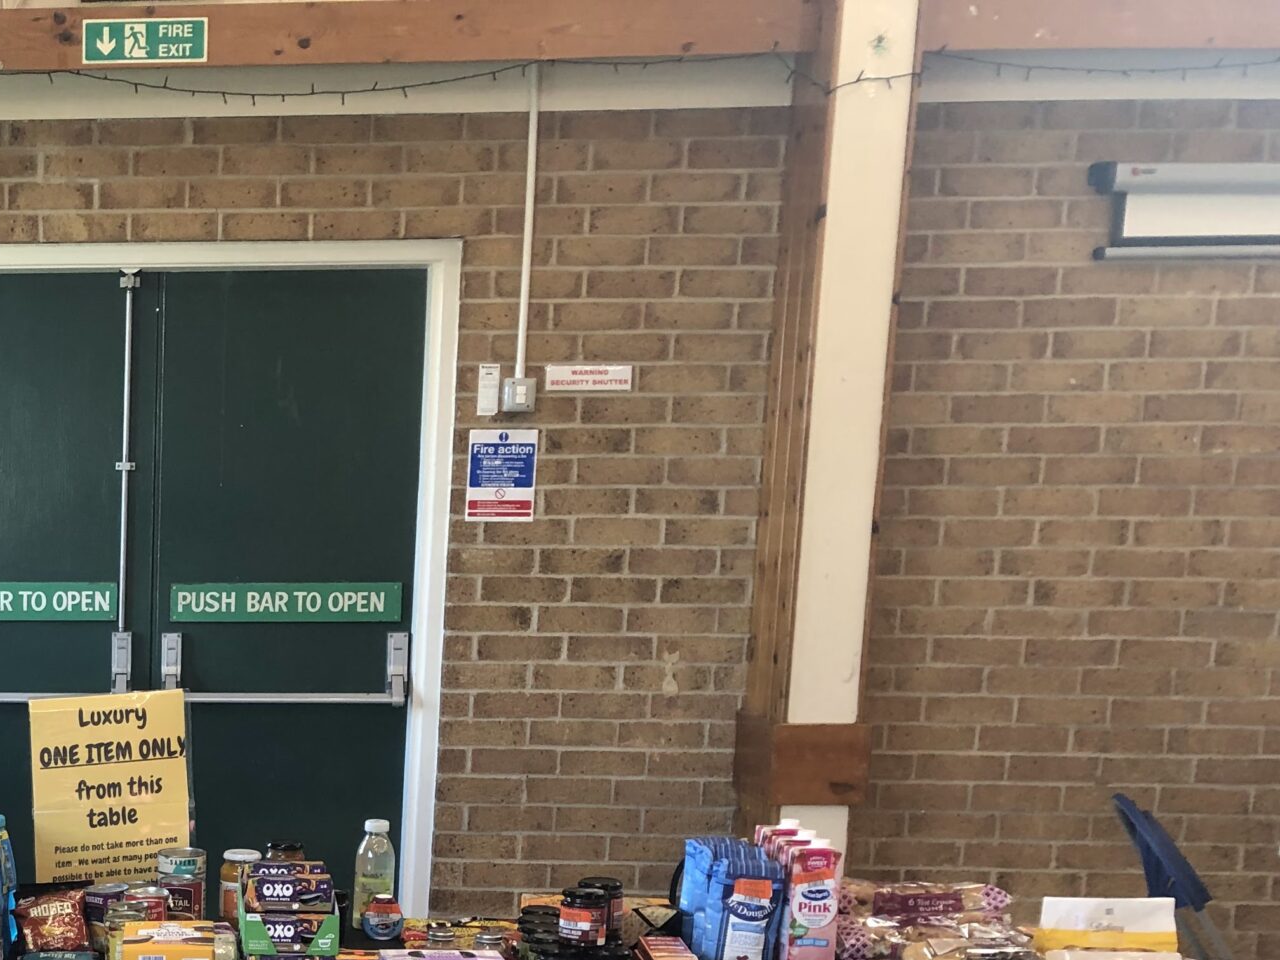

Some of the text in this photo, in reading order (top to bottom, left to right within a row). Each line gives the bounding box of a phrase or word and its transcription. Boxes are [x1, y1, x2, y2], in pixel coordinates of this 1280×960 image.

[158, 24, 193, 37] FIRE
[158, 44, 192, 57] EXIT
[473, 444, 533, 454] Fire action
[19, 591, 46, 611] TO
[52, 591, 110, 611] OPEN
[177, 591, 385, 612] PUSH BAR TO OPEN
[78, 707, 147, 729] Luxury
[39, 736, 186, 767] ONE ITEM ONLY
[75, 775, 163, 801] from this
[86, 806, 138, 828] table
[54, 845, 78, 854] Please
[80, 843, 90, 851] do
[106, 841, 123, 850] take
[125, 839, 144, 848] more
[146, 837, 163, 846] than
[164, 836, 178, 844] one
[55, 860, 72, 868] item
[78, 858, 89, 866] We
[91, 856, 110, 864] want
[112, 855, 120, 863] as
[122, 854, 142, 863] many
[52, 873, 83, 883] possible
[84, 872, 93, 880] to
[94, 870, 104, 878] be
[106, 869, 122, 877] able
[124, 867, 132, 875] to
[133, 866, 152, 874] have
[262, 883, 294, 897] OXO
[174, 899, 191, 907] TAIL
[798, 902, 832, 913] Pink
[265, 924, 295, 938] OXO
